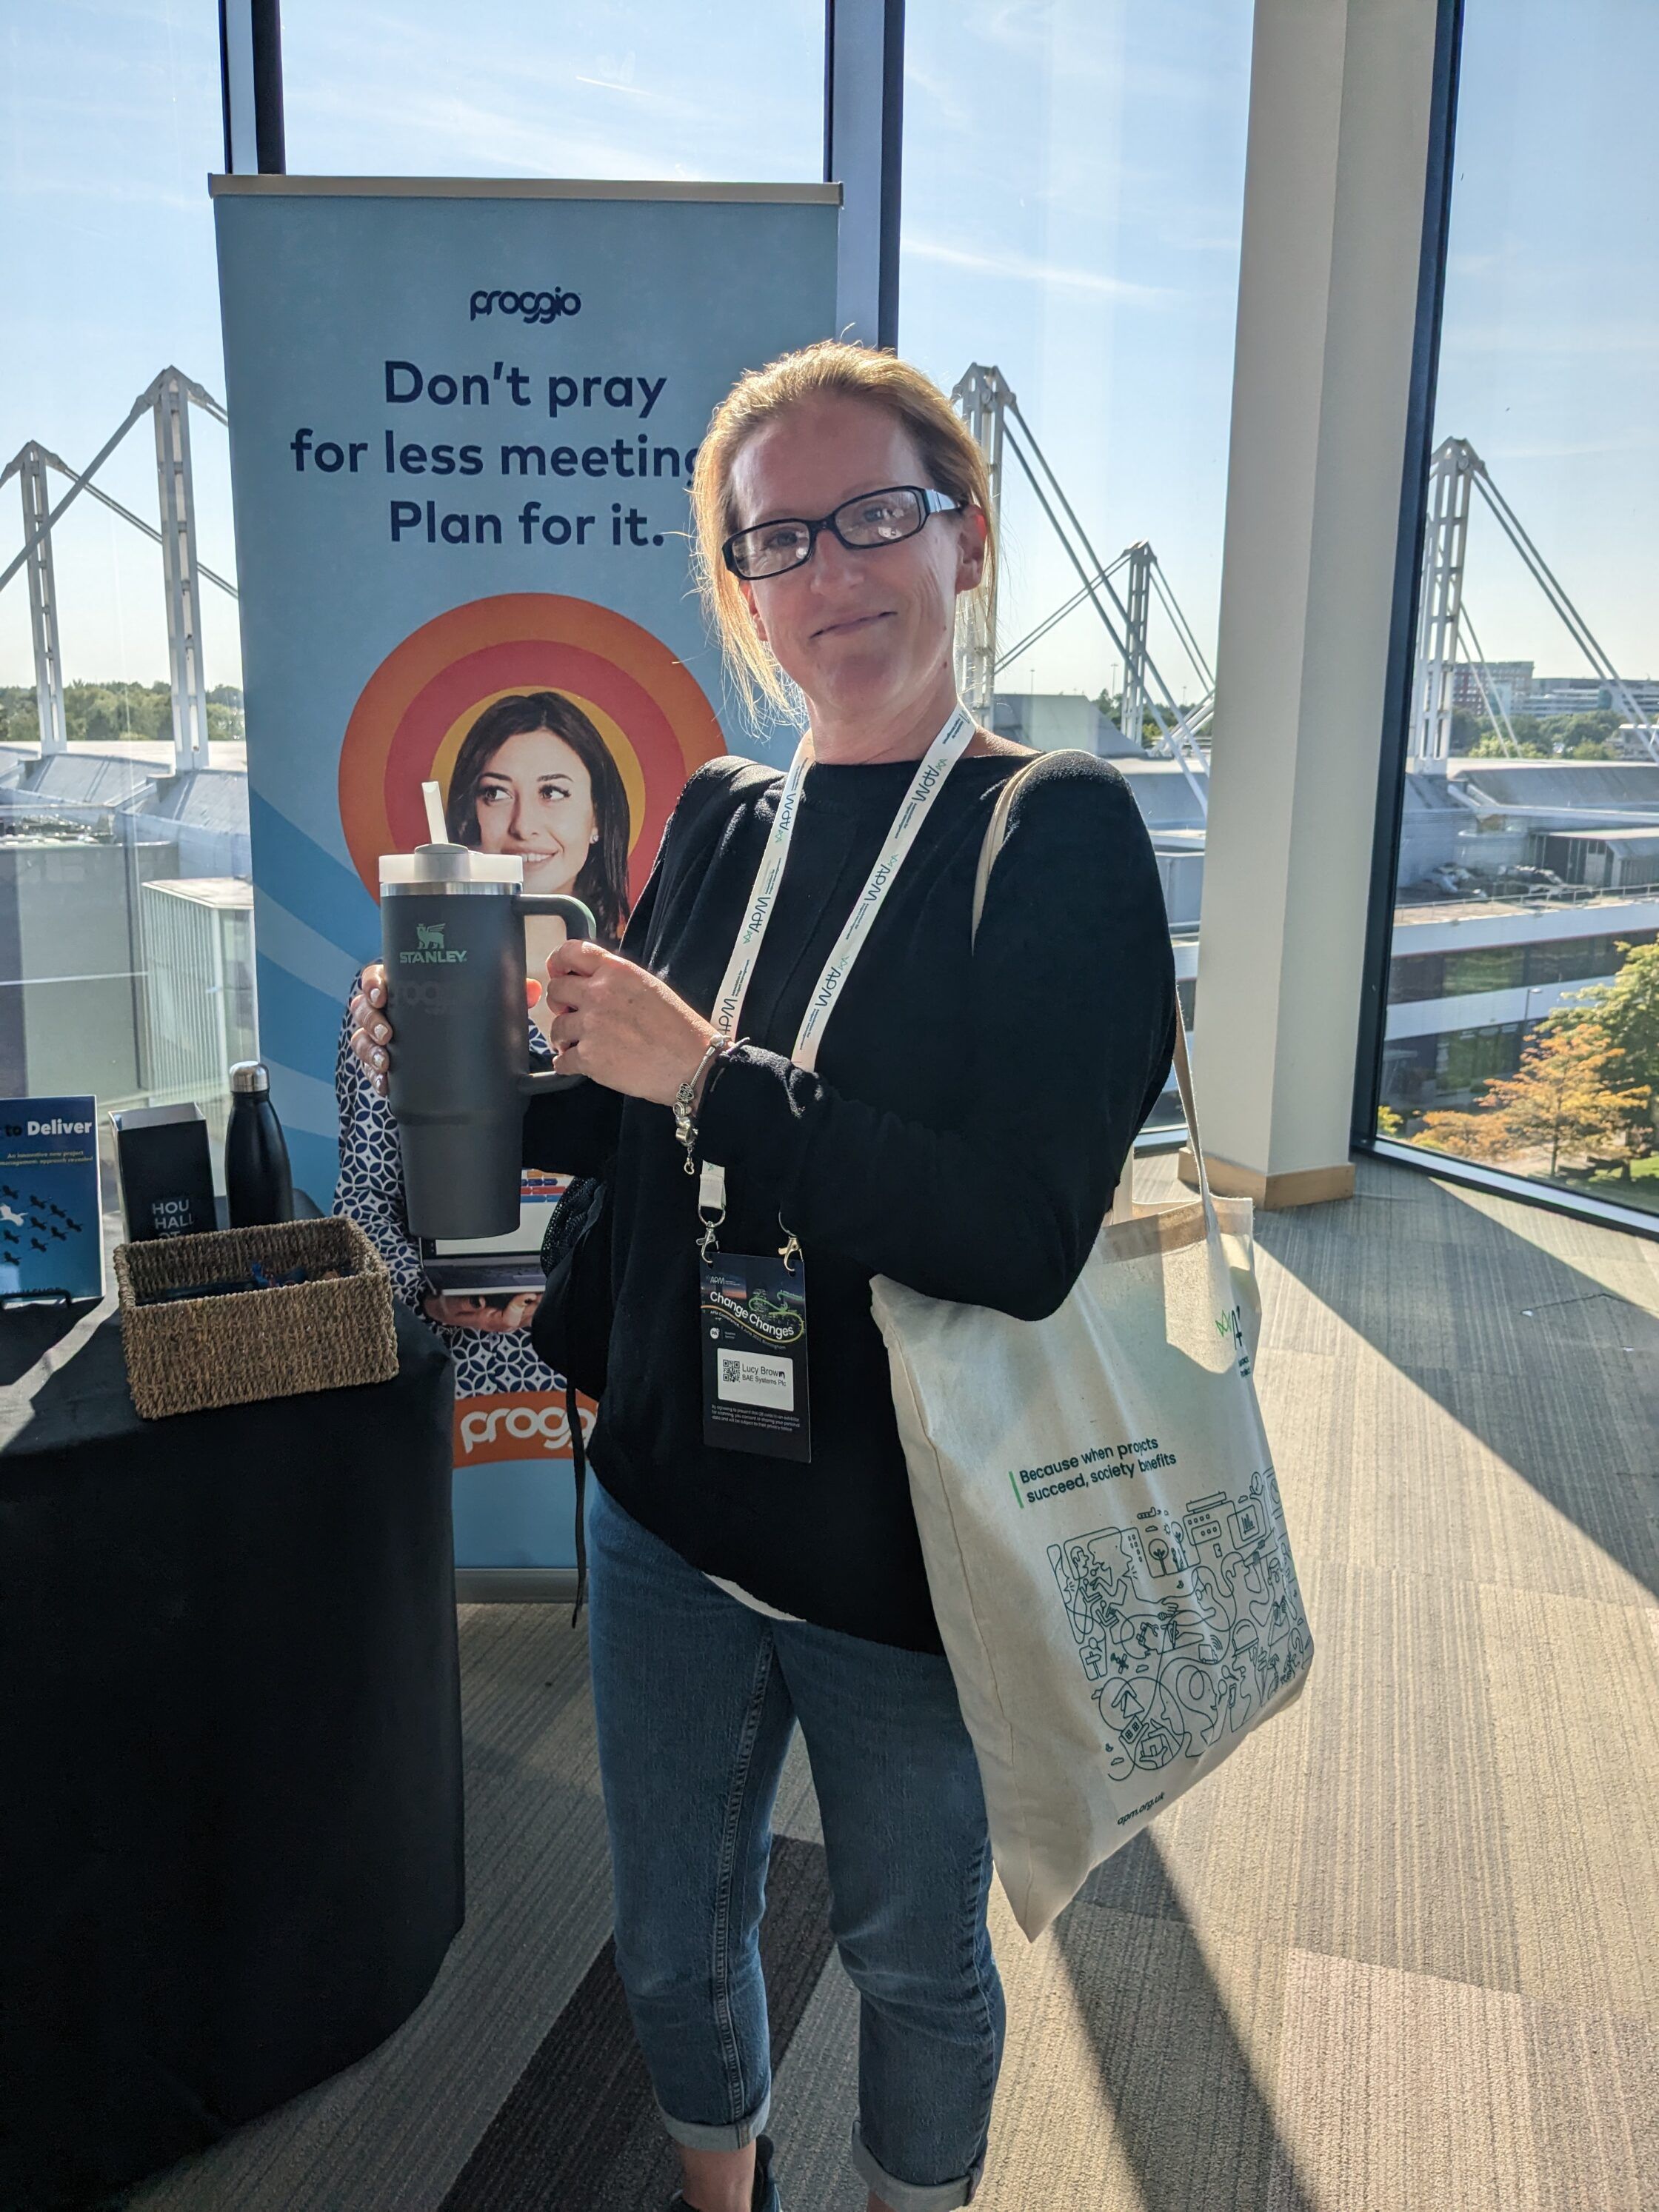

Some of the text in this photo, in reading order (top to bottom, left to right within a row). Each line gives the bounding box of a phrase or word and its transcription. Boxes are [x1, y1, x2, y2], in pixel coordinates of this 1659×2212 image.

[470, 287, 581, 324] proggio
[384, 360, 667, 418] Don't pray
[290, 427, 368, 473] for
[385, 430, 484, 475] less
[390, 500, 664, 546] Plan for it.
[912, 765, 939, 801] APM
[779, 792, 797, 831] APM
[864, 864, 890, 900] APM
[749, 897, 771, 933] APM
[399, 950, 467, 963] STANLEY
[815, 966, 841, 1006] APM
[27, 1118, 93, 1136] Deliver
[152, 1198, 190, 1214] HOU
[710, 1276, 724, 1285] APM
[710, 1291, 794, 1340] Change Changes
[742, 1363, 758, 1375] Lucy
[755, 1376, 777, 1385] Systems
[778, 1379, 787, 1387] Plc
[1019, 1437, 1159, 1484] Because when procts
[1027, 1473, 1089, 1503] succeed,
[1091, 1462, 1135, 1484] society
[1117, 1791, 1165, 1827] apm.org.uk
